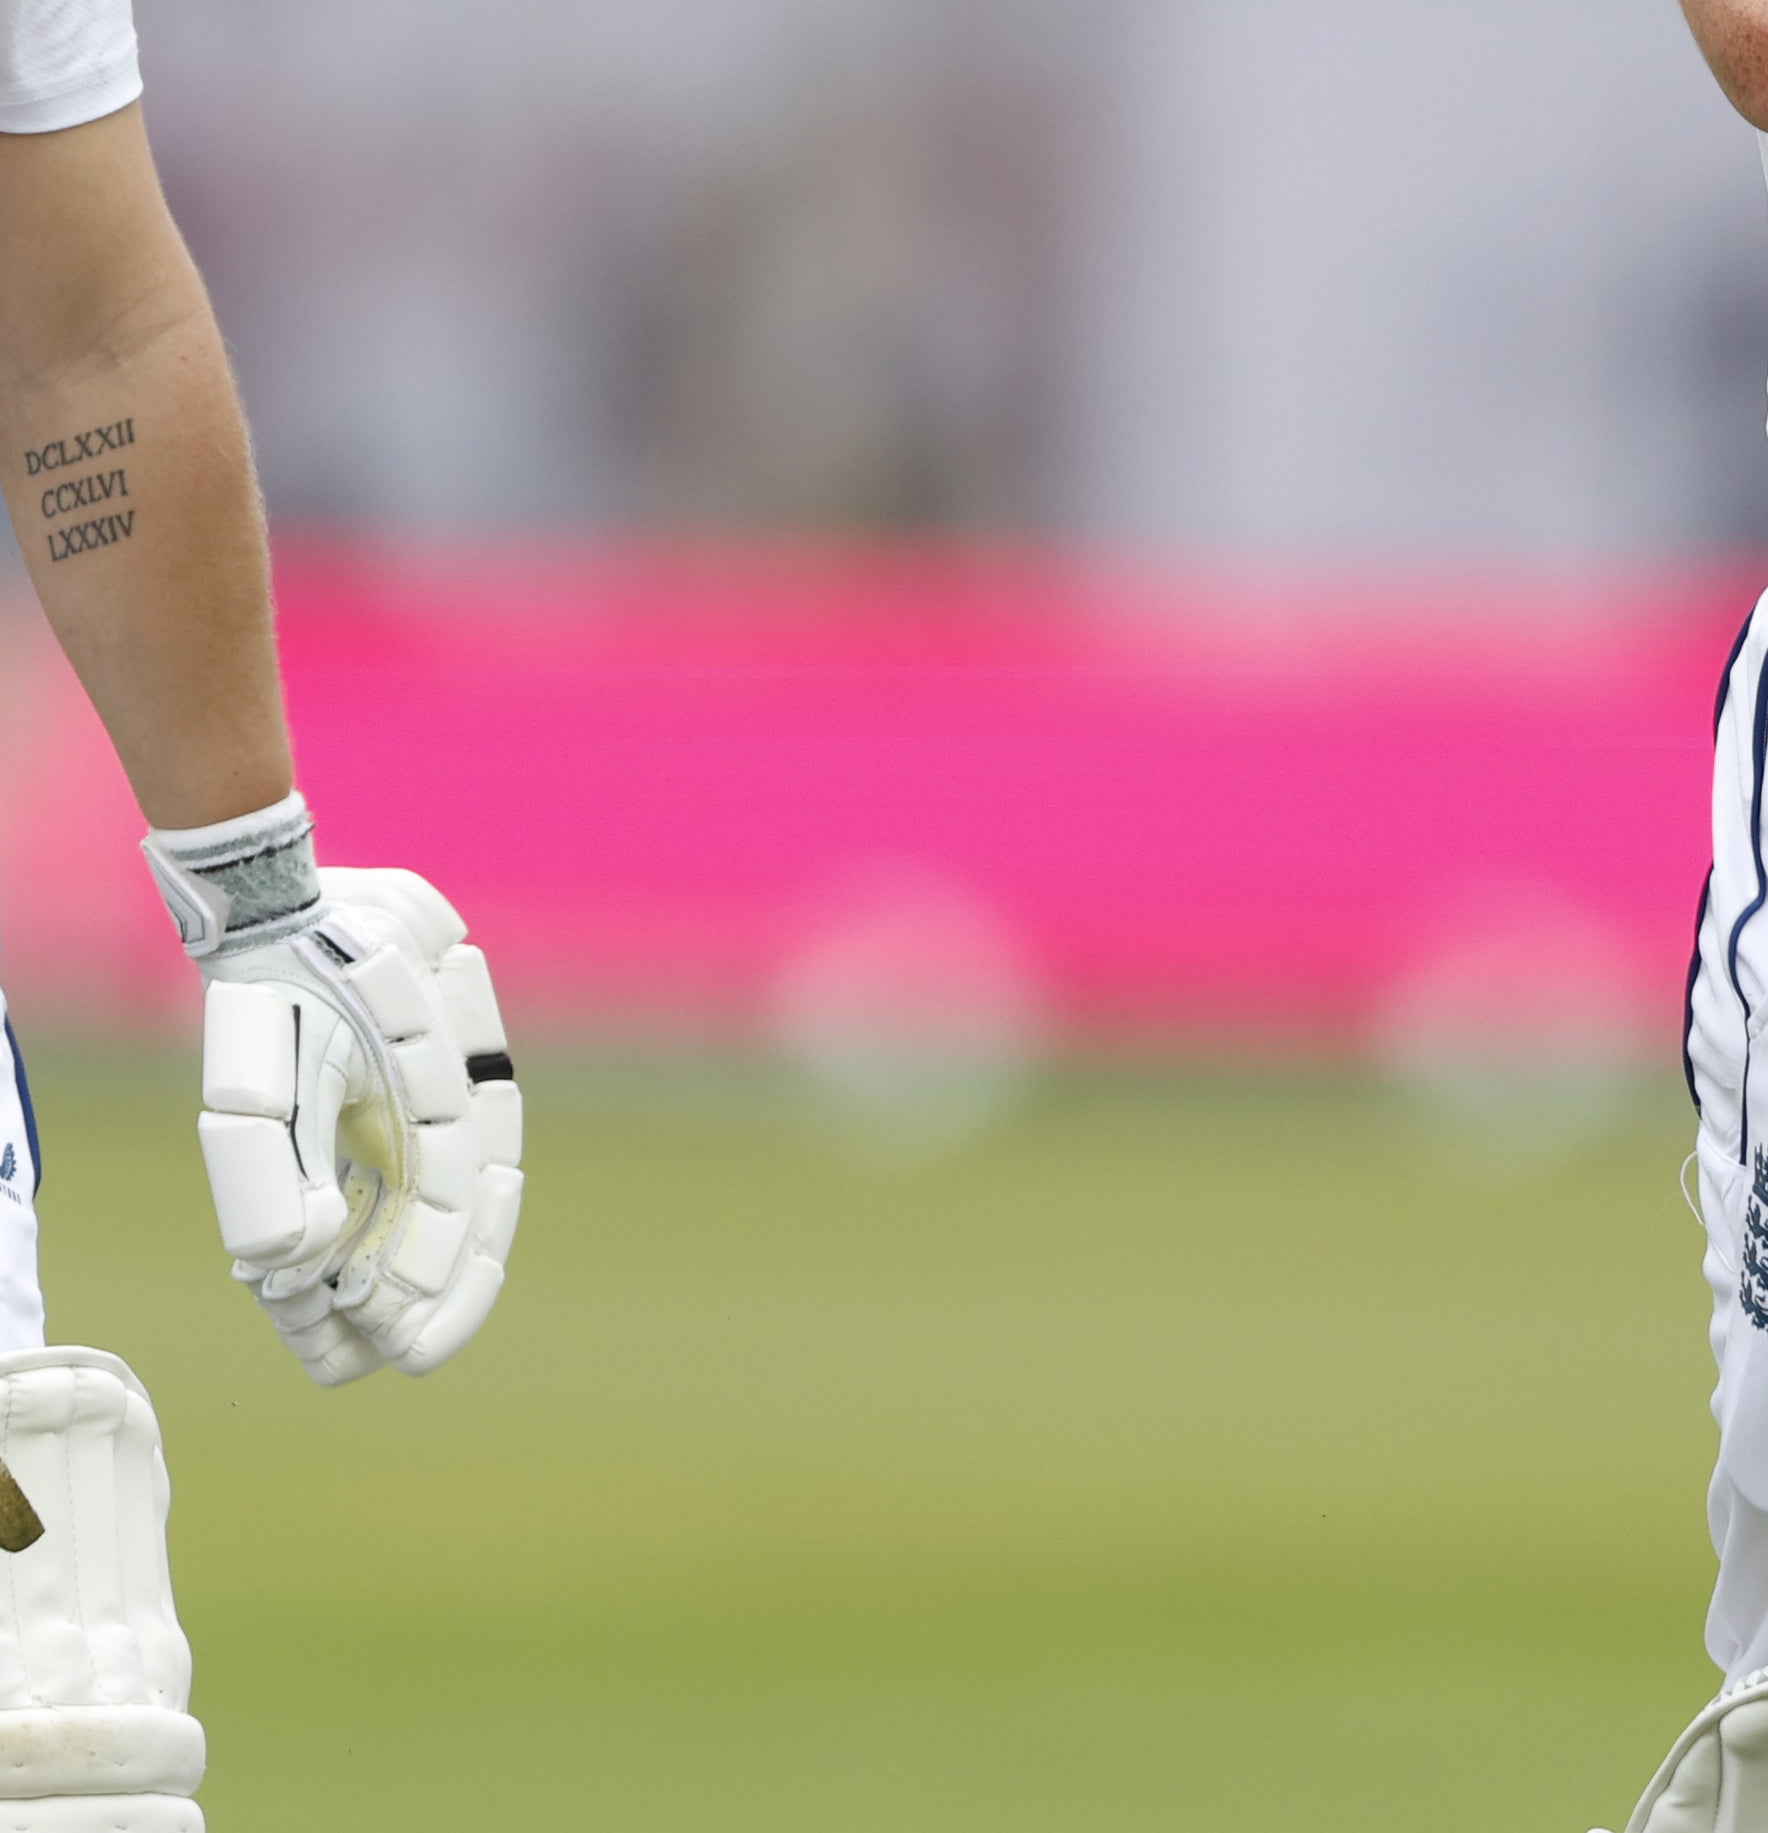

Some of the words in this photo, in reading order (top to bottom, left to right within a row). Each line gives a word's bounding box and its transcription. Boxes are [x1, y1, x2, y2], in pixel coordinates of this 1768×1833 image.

[25, 417, 136, 476] DCLXXII
[41, 468, 129, 519] CCXLVI
[47, 510, 136, 563] LXXXIV
